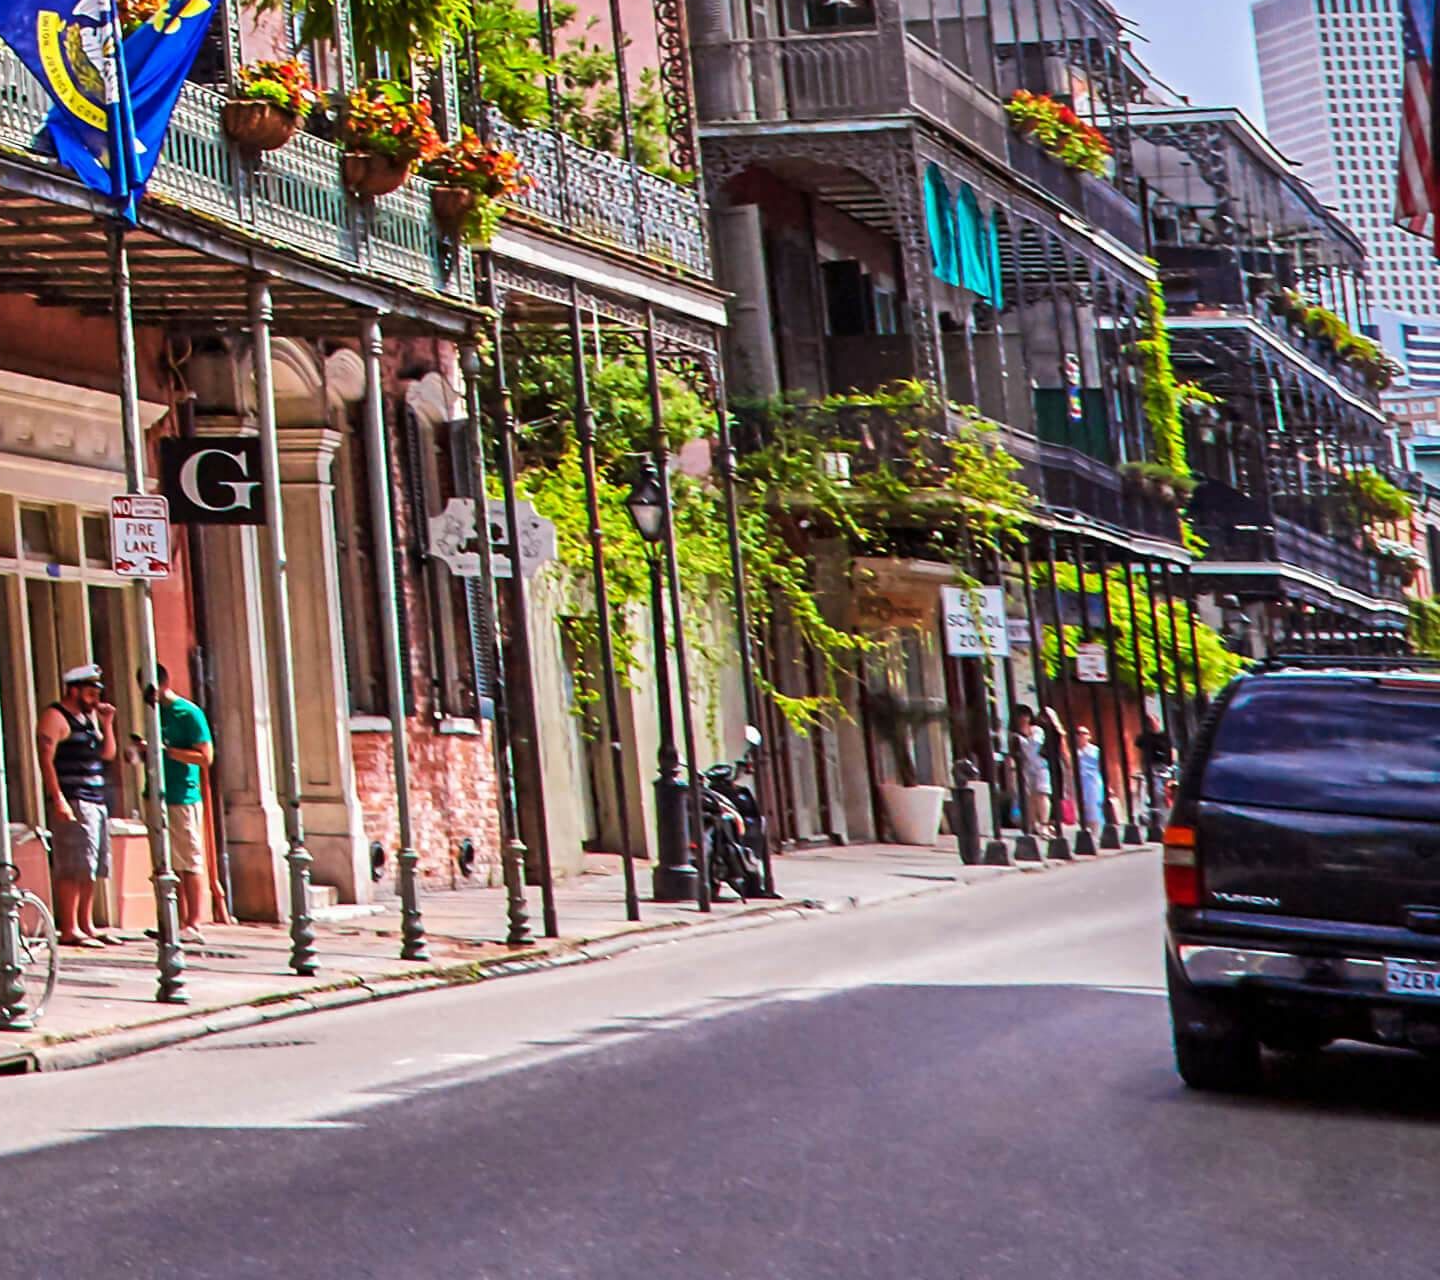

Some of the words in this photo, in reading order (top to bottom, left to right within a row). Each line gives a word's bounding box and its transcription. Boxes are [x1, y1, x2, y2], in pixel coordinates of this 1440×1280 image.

[180, 448, 262, 512] G
[113, 500, 131, 515] NO
[126, 523, 155, 537] FIRE
[124, 540, 159, 554] LANE
[959, 594, 988, 608] ED
[947, 614, 1004, 629] SCHOL
[959, 634, 997, 649] ZOE
